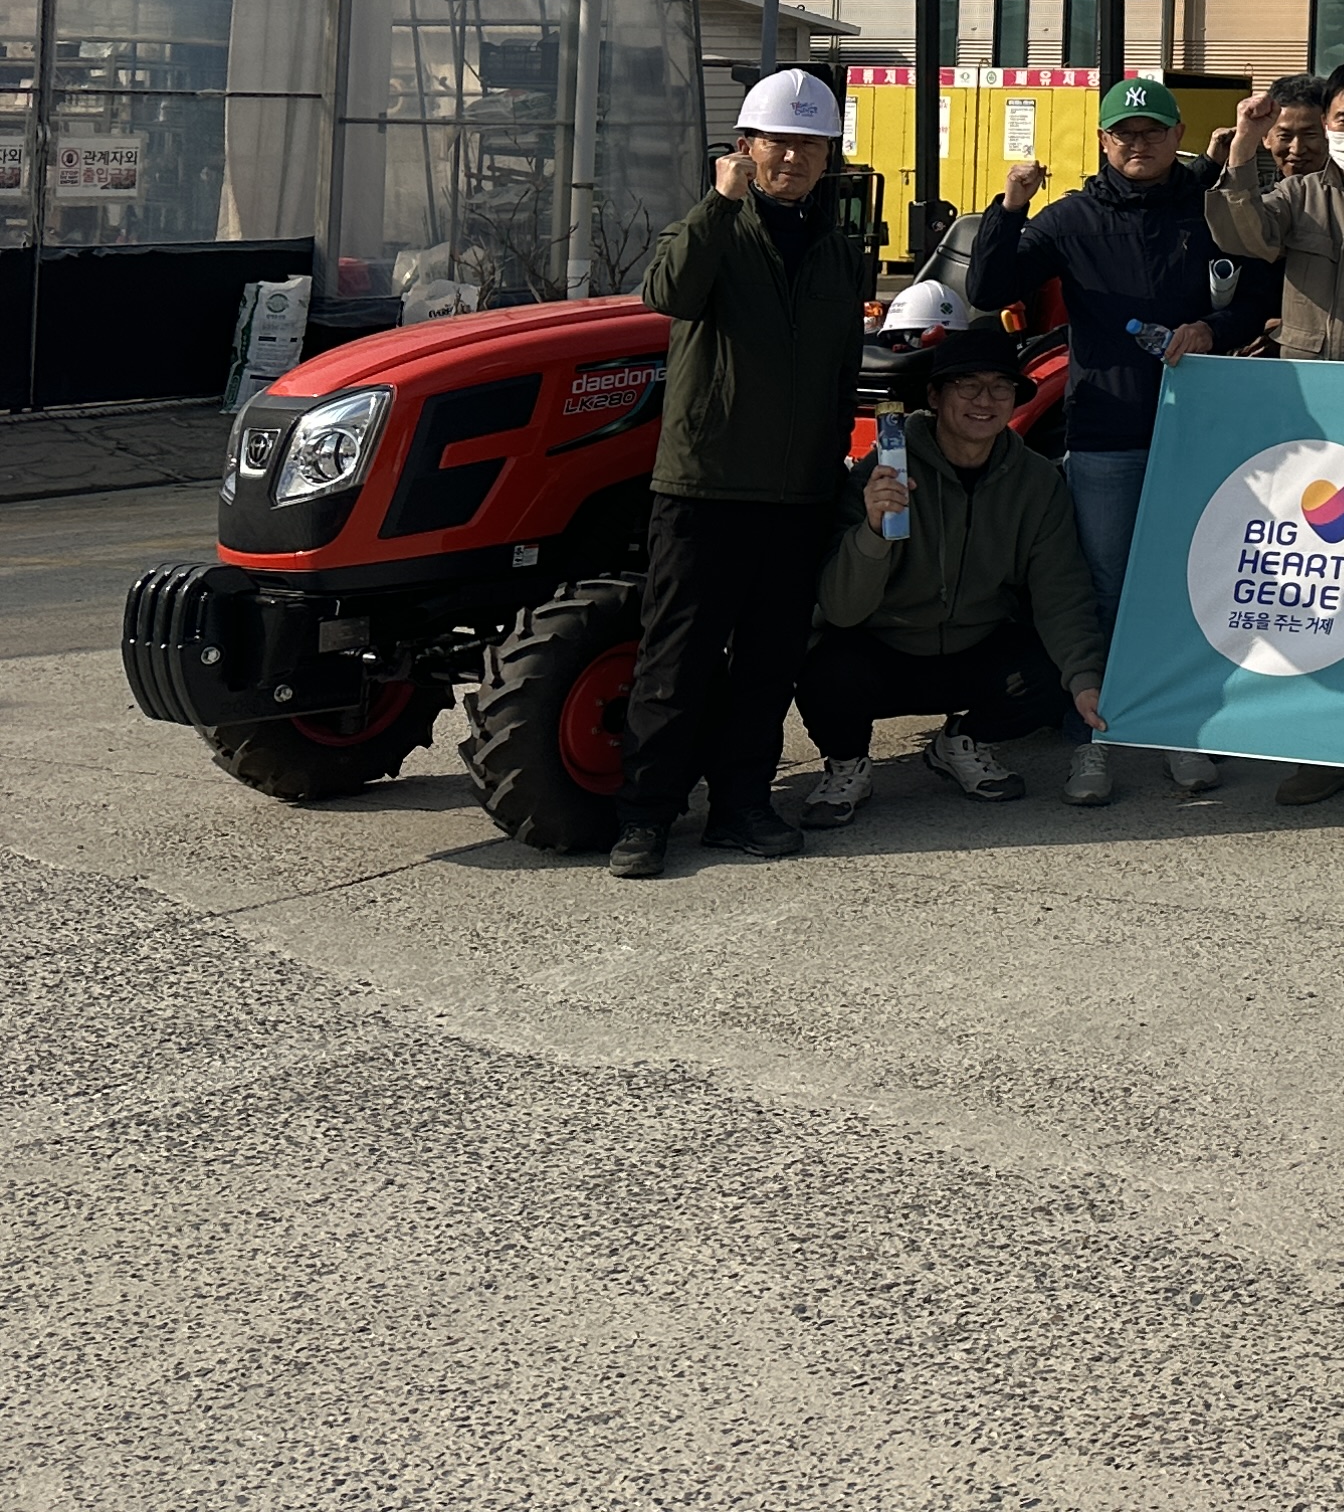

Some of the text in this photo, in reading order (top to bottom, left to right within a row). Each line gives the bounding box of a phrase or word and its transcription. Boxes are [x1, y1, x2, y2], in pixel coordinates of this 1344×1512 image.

[82, 149, 139, 166] 관계자외
[563, 389, 637, 415] LK280
[1243, 519, 1298, 546] BIG
[1233, 579, 1340, 610] GEOJE
[1228, 611, 1335, 635] 감동을 주는 거제
